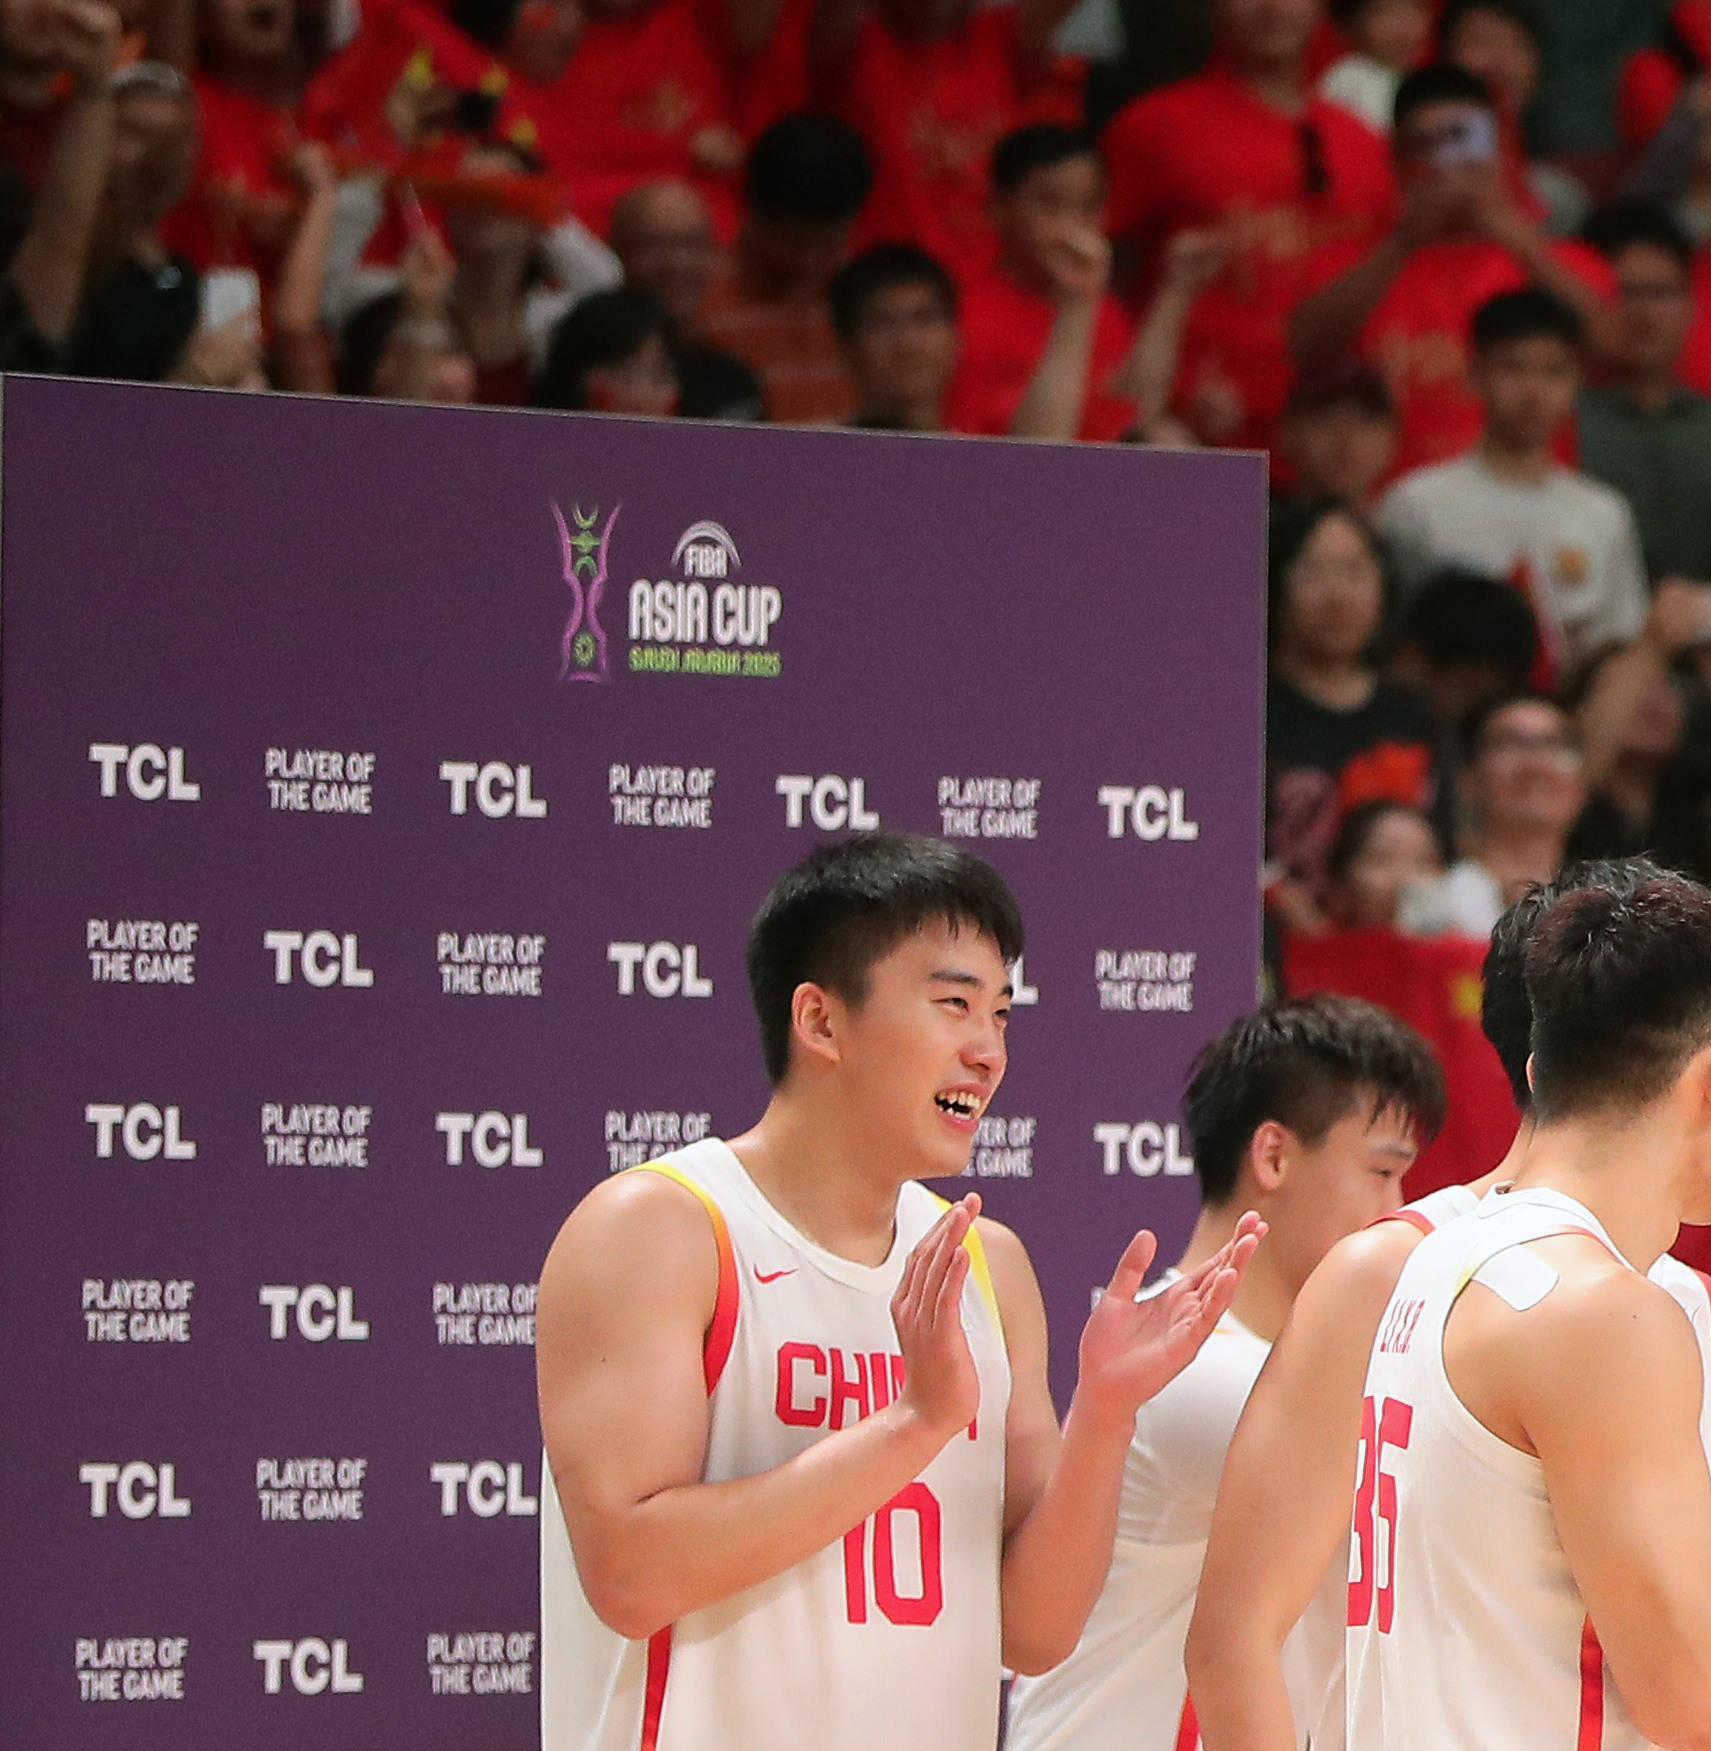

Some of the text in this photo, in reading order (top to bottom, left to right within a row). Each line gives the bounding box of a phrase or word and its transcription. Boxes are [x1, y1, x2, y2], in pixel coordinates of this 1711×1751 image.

[628, 578, 783, 647] ASIA CUP
[89, 743, 201, 801] TCL
[265, 747, 376, 783] PLAYER OF
[608, 763, 716, 798] PLAYER OF
[267, 779, 373, 815] THE GAME
[439, 761, 547, 818] TCL
[775, 774, 880, 831] TCL
[937, 776, 1042, 809] PLAYER OF
[610, 794, 712, 829] THE GAME
[940, 806, 1038, 839] THE GAME
[1098, 785, 1199, 841] TCL
[86, 918, 199, 953] PLAYER OF
[437, 932, 546, 965] PLAYER OF
[88, 950, 196, 985] THE GAME
[263, 930, 374, 988] TCL
[607, 941, 713, 998] TCL
[1095, 949, 1197, 983] PLAYER OF
[438, 963, 542, 997] THE GAME
[1097, 980, 1193, 1012] THE GAME
[85, 1102, 196, 1160] TCL
[261, 1103, 372, 1136] PLAYER OF
[605, 1111, 712, 1143] PLAYER OF
[263, 1134, 369, 1168] THE GAME
[435, 1111, 543, 1168] TCL
[1093, 1121, 1194, 1177] TCL
[82, 1278, 195, 1311] PLAYER OF
[432, 1283, 511, 1314] PLAYER
[83, 1311, 191, 1343] THE GAME
[259, 1284, 370, 1342] TCL
[435, 1313, 537, 1345] THE GAME
[79, 1461, 191, 1519] TCL
[256, 1458, 368, 1489] PLAYER OF
[430, 1460, 538, 1518] TCL
[258, 1489, 364, 1521] THE GAME
[843, 1482, 944, 1627] 10
[75, 1637, 189, 1669] PLAYER OF
[427, 1631, 534, 1664] PLAYER OF
[253, 1638, 364, 1695] TCL
[429, 1663, 532, 1695] THE GAME
[77, 1669, 185, 1701] THE GAME
